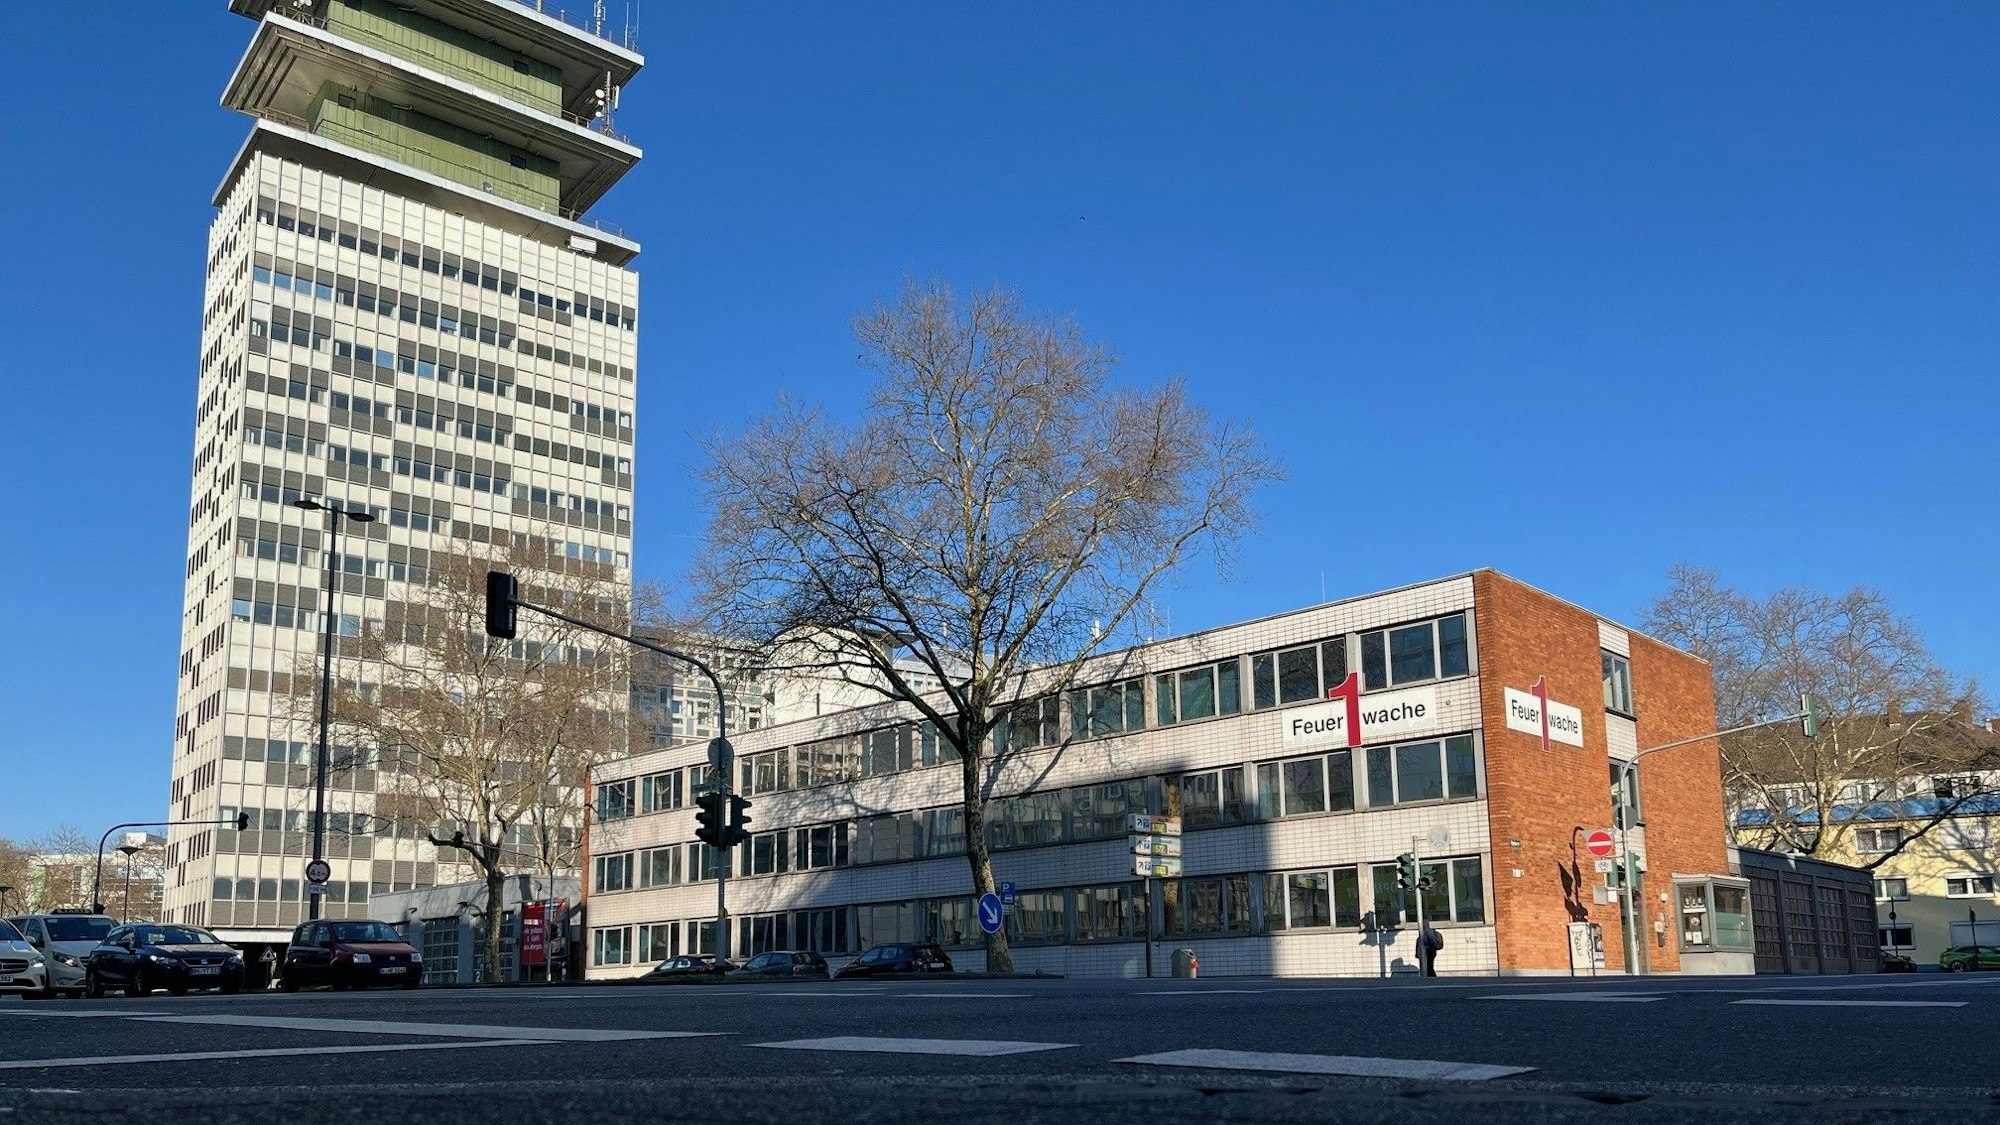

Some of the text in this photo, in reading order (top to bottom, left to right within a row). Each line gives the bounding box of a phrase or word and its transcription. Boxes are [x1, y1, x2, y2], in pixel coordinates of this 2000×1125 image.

[1292, 673, 1426, 747] Feuer 1 wache
[1510, 675, 1579, 752] Feuer 1 wache
[1003, 883, 1009, 892] P
[475, 971, 481, 983] 2
